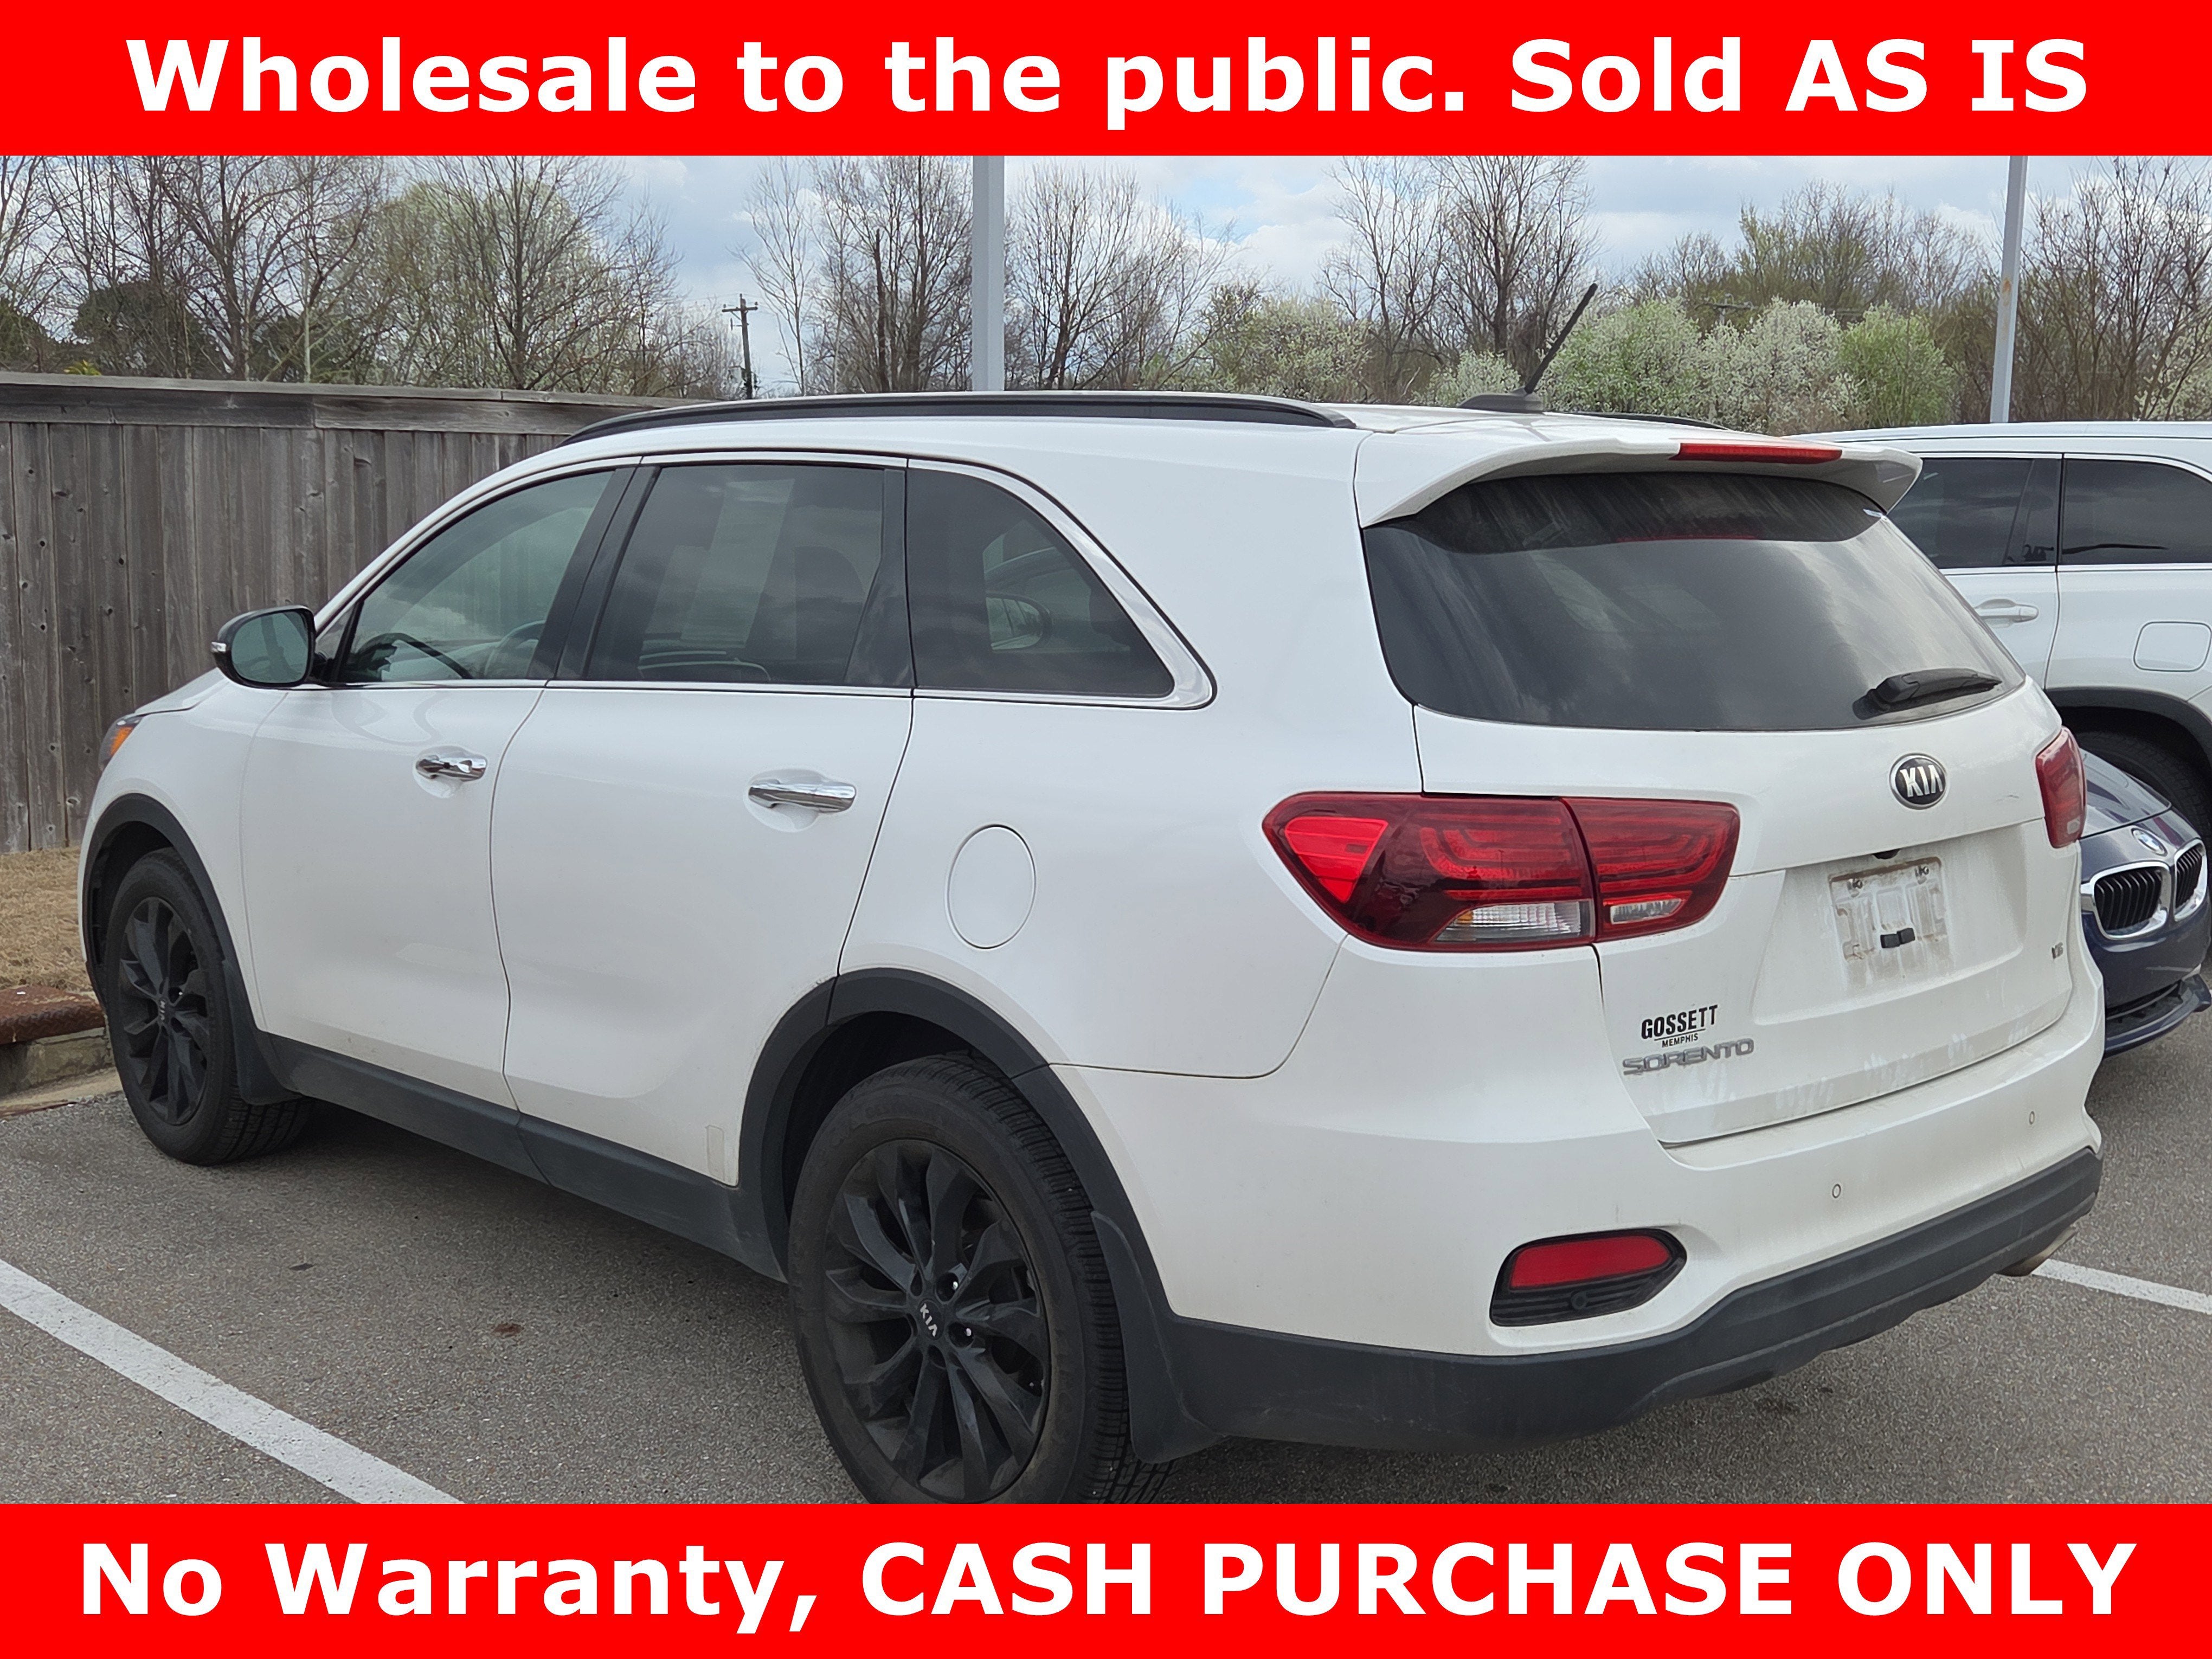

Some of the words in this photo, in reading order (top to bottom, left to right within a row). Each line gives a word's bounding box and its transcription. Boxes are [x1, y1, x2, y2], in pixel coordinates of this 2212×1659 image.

[1900, 764, 1943, 798] KIA
[1641, 1005, 1718, 1039] GOSSETT
[1623, 1038, 1754, 1075] SORENTO
[1662, 1033, 1699, 1048] MEMPHIS
[920, 1303, 938, 1337] KIA
